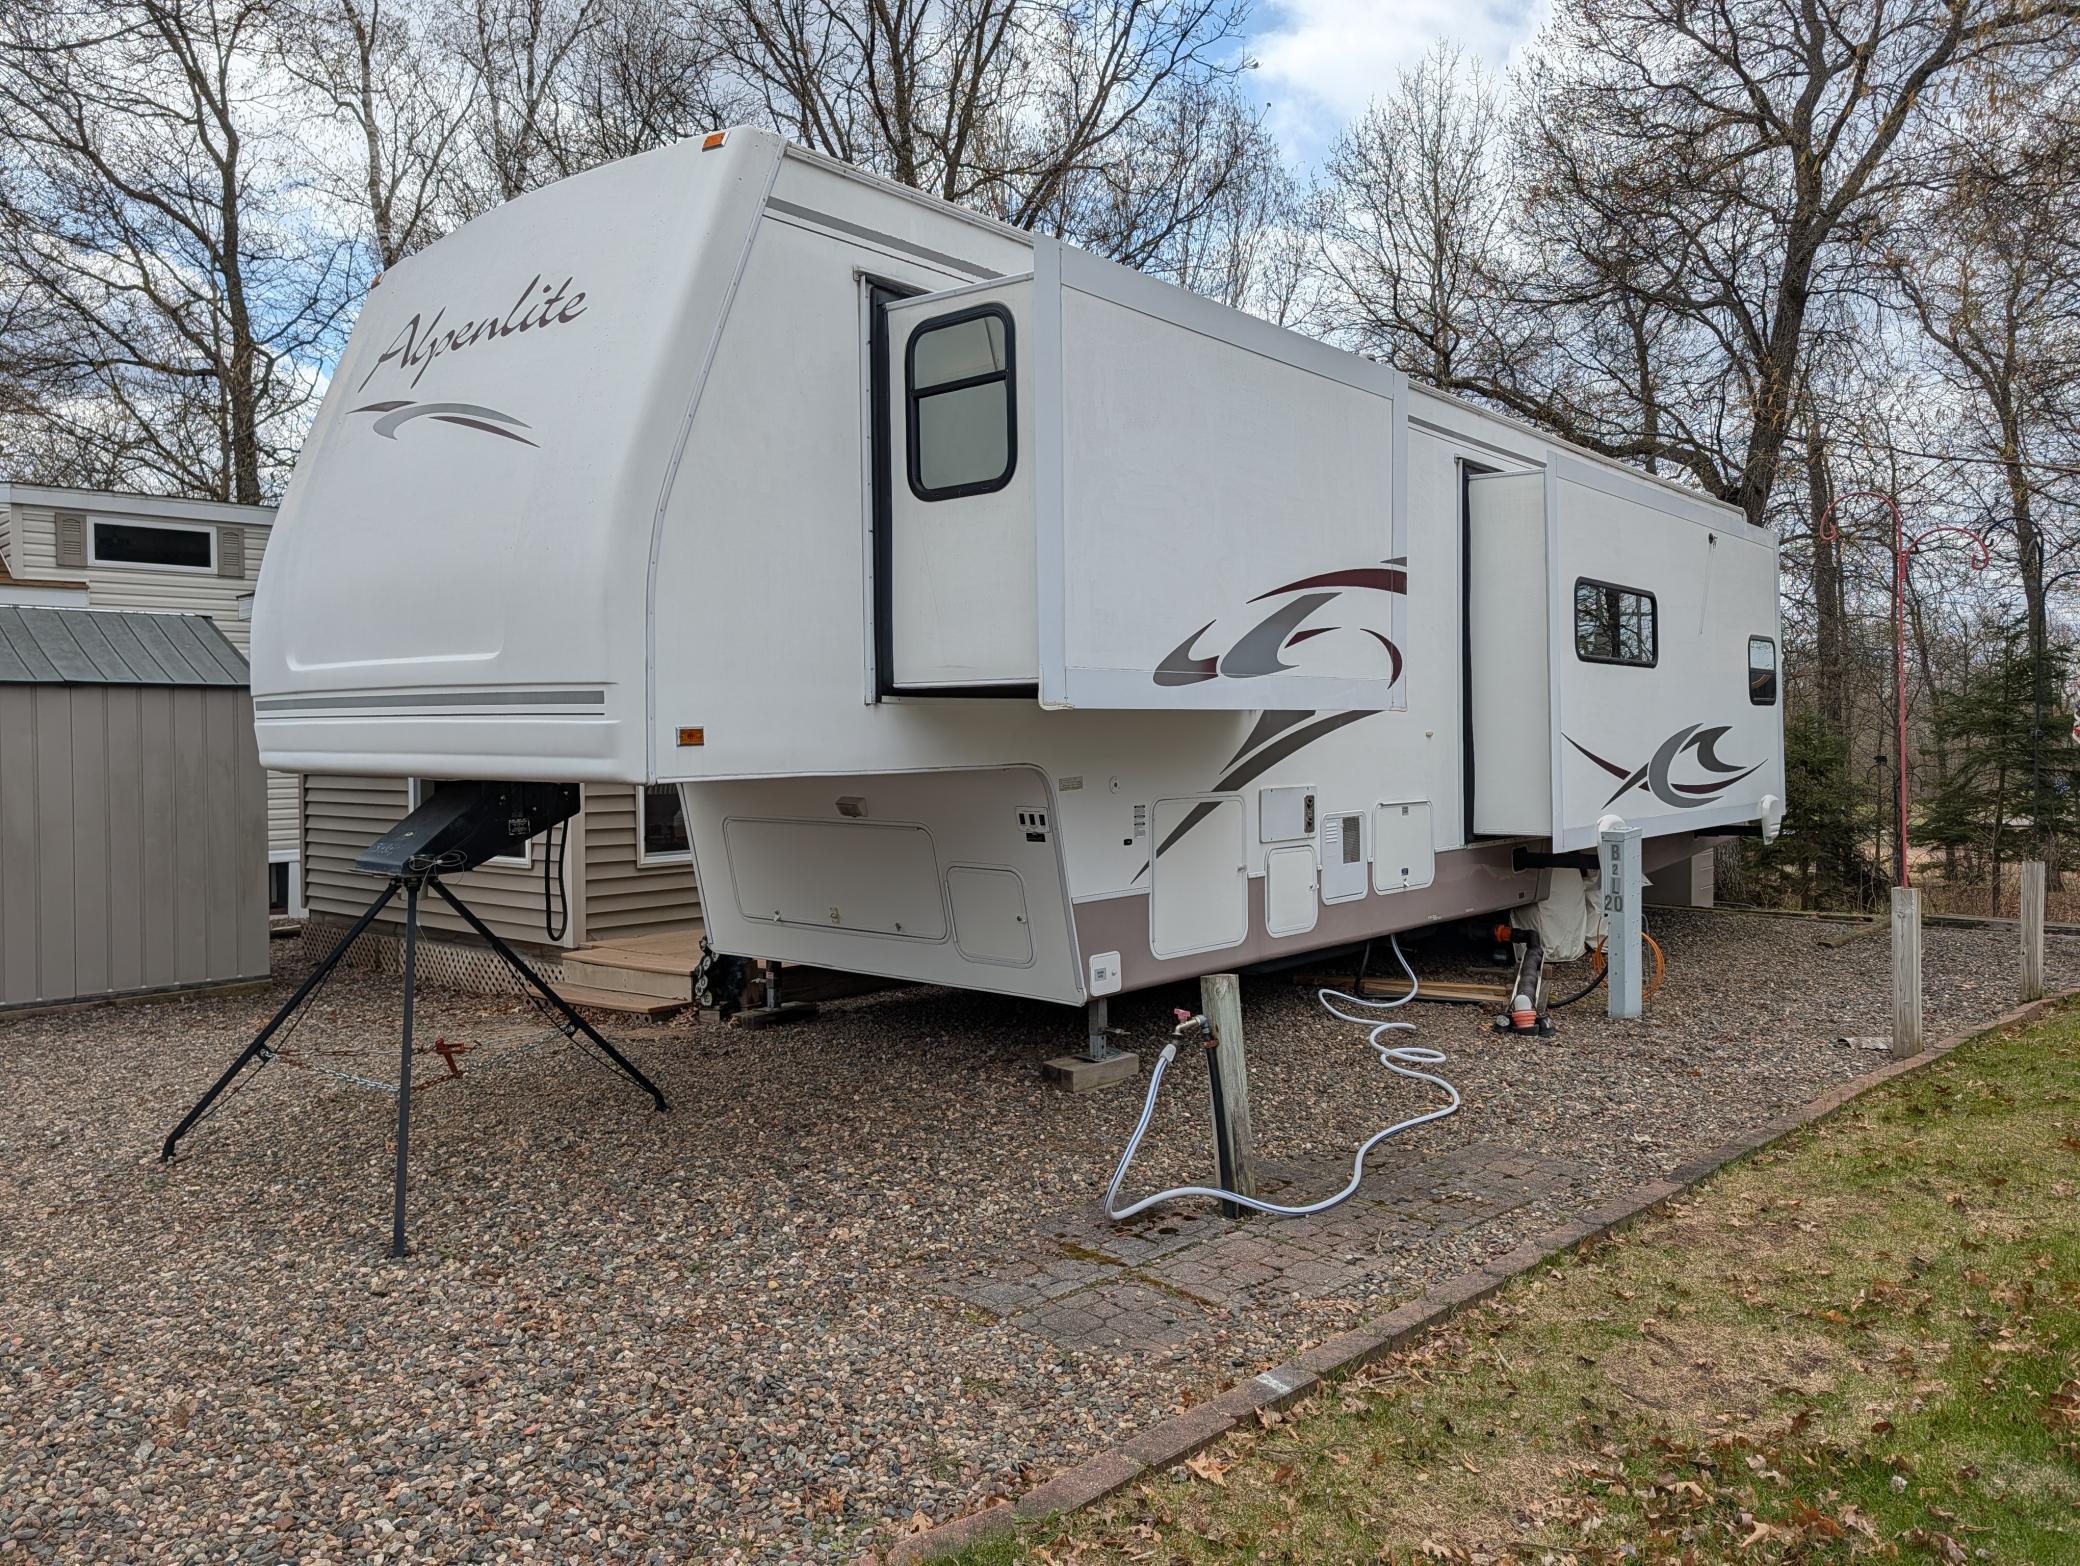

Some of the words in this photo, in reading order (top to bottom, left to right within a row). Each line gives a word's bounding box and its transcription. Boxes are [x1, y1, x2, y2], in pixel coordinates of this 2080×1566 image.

[357, 273, 588, 393] Alpenlite
[1611, 844, 1621, 861] B
[1611, 863, 1619, 876] 2
[1611, 878, 1620, 895] L
[1604, 895, 1623, 913] 20
